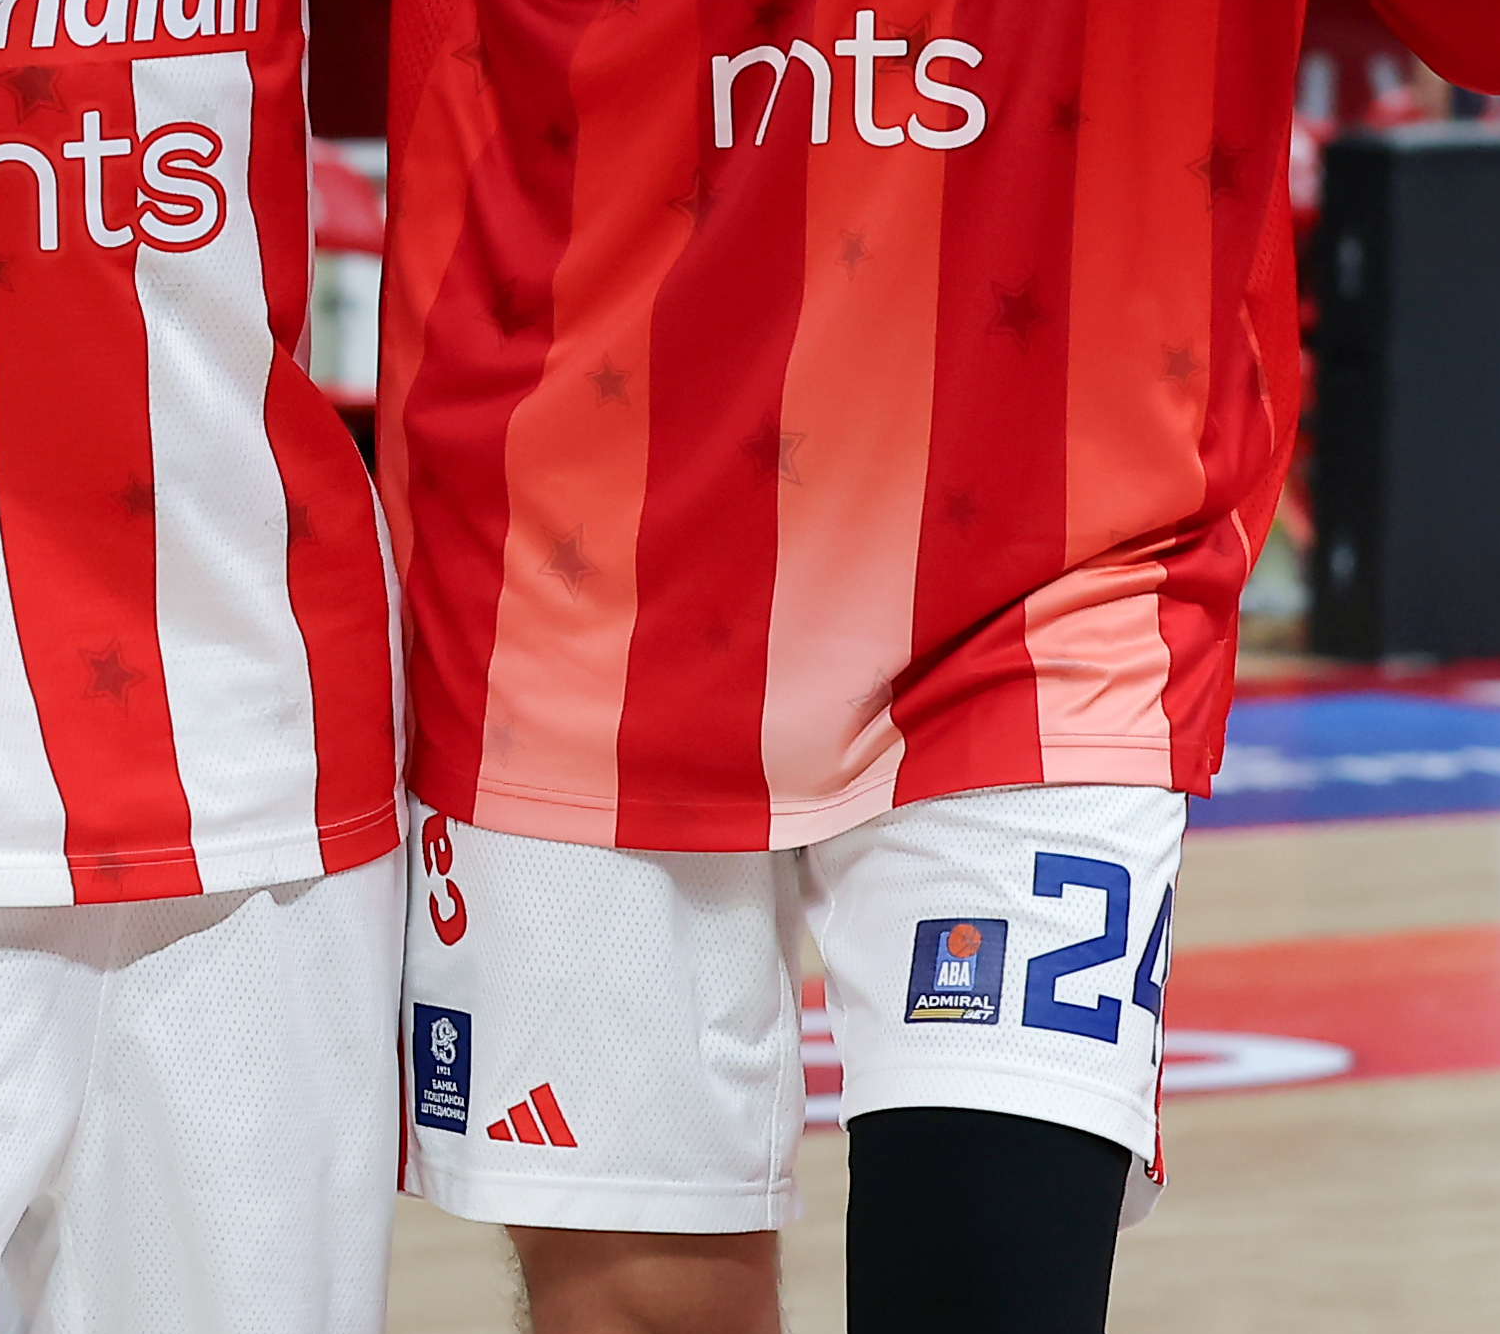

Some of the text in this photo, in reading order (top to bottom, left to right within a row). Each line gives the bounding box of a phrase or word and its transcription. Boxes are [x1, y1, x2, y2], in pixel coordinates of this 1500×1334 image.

[711, 8, 987, 149] mts
[937, 961, 970, 986] ABA
[915, 994, 995, 1010] ADMIRAL
